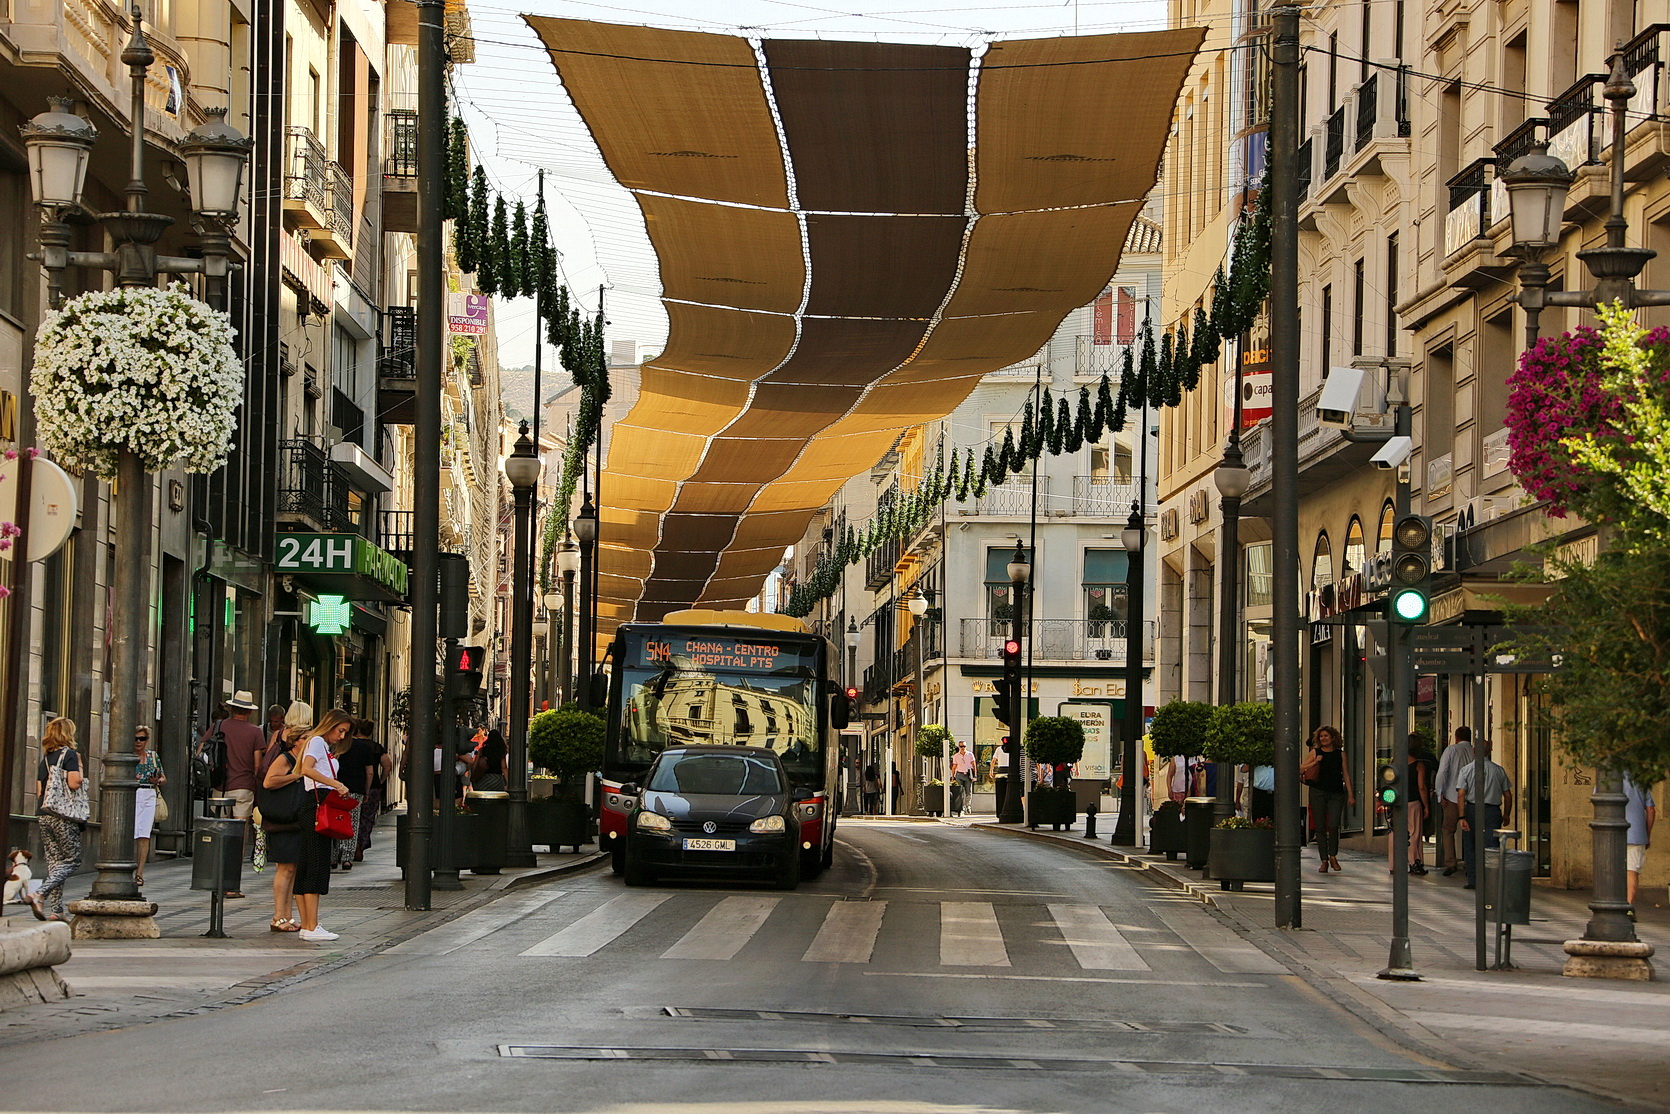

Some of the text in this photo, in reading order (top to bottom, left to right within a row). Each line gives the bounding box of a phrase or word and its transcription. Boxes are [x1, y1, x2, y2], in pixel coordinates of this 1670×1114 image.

[450, 317, 487, 327] DISPONIBLE
[450, 324, 486, 334] 958 210 291
[1243, 345, 1272, 365] paci
[278, 538, 352, 568] 24H
[1415, 631, 1439, 640] atedral
[646, 641, 671, 662] SN4
[686, 641, 723, 654] CHANA
[734, 644, 779, 657] CENTRO
[691, 653, 773, 669] HOSPITAL PTS
[1106, 683, 1126, 697] Elo
[690, 839, 731, 850] 4526 GML
